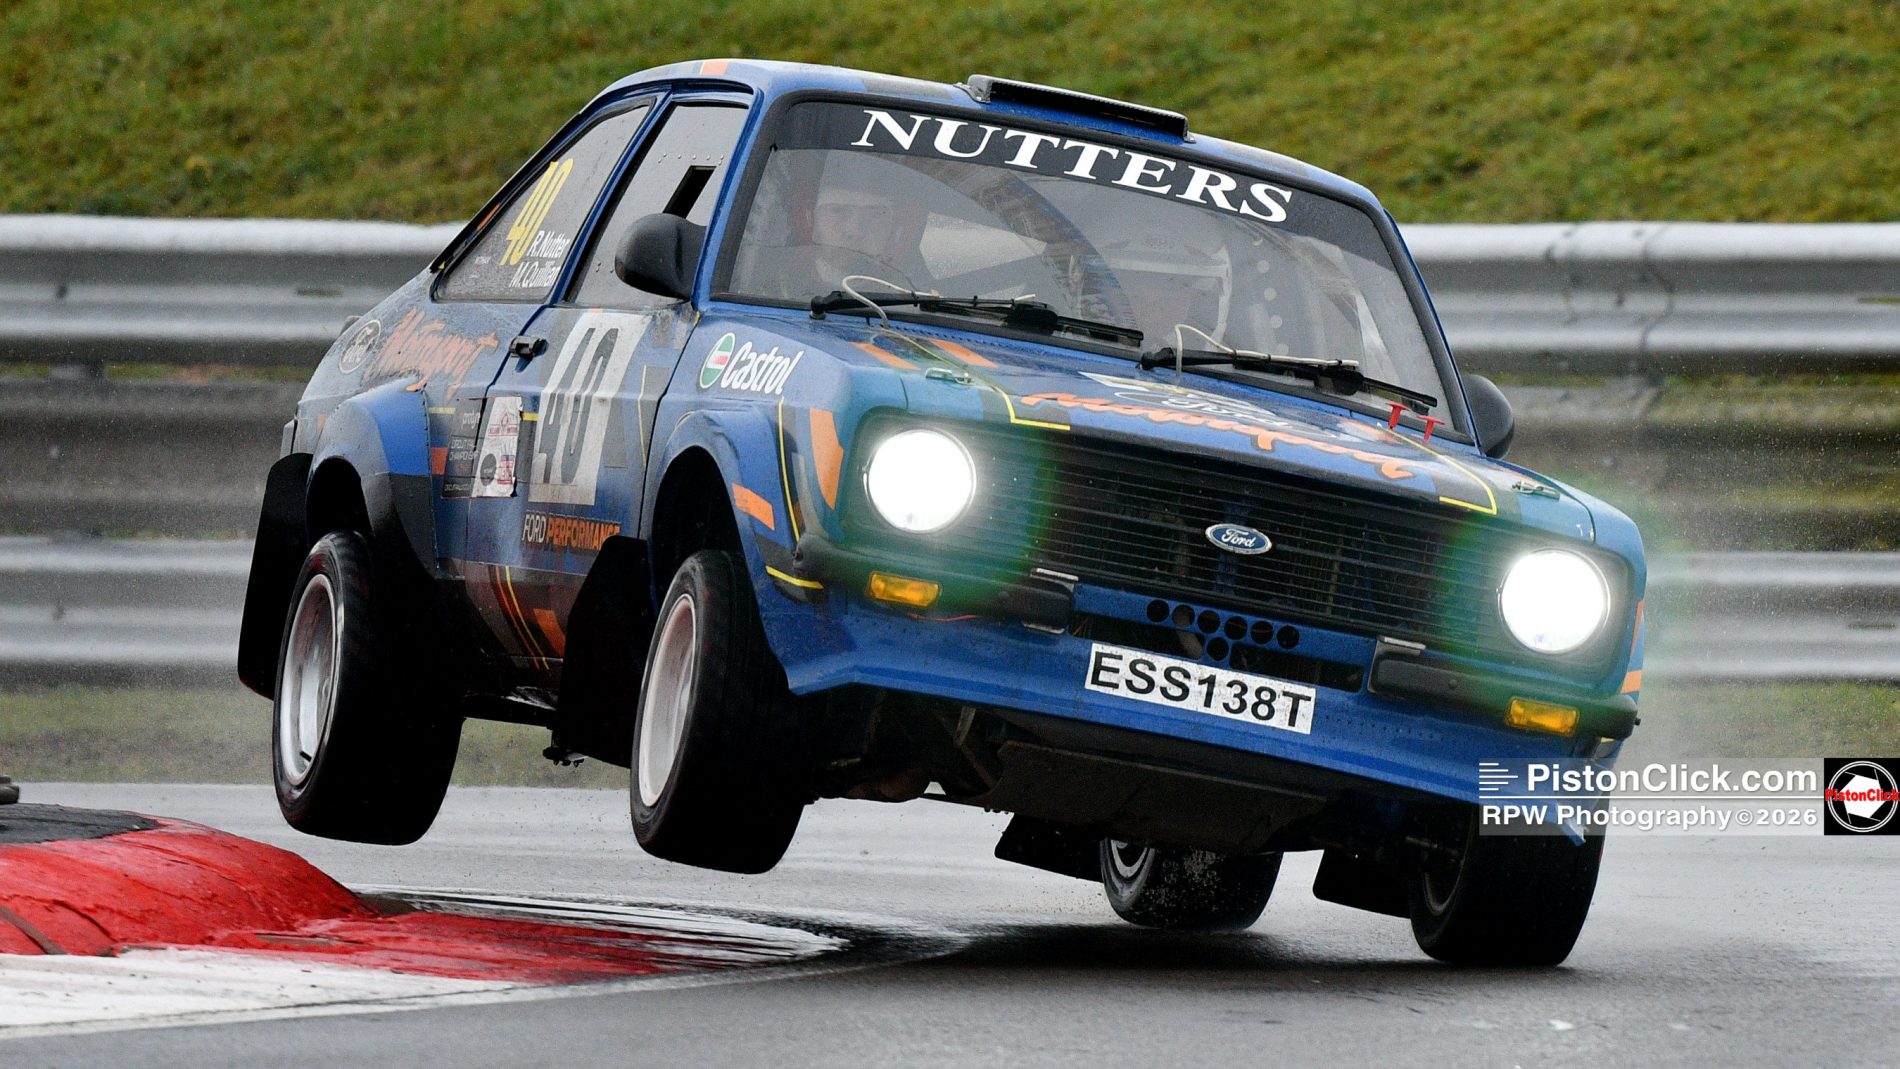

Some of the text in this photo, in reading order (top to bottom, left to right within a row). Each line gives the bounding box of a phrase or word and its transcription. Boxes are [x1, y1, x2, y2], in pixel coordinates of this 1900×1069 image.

[850, 110, 1292, 223] NUTTERS
[500, 159, 574, 266] 40
[538, 327, 619, 484] 40
[720, 341, 804, 395] Castrol
[522, 514, 547, 543] FORD
[1221, 528, 1256, 548] Ford
[1090, 651, 1312, 727] ESS138T
